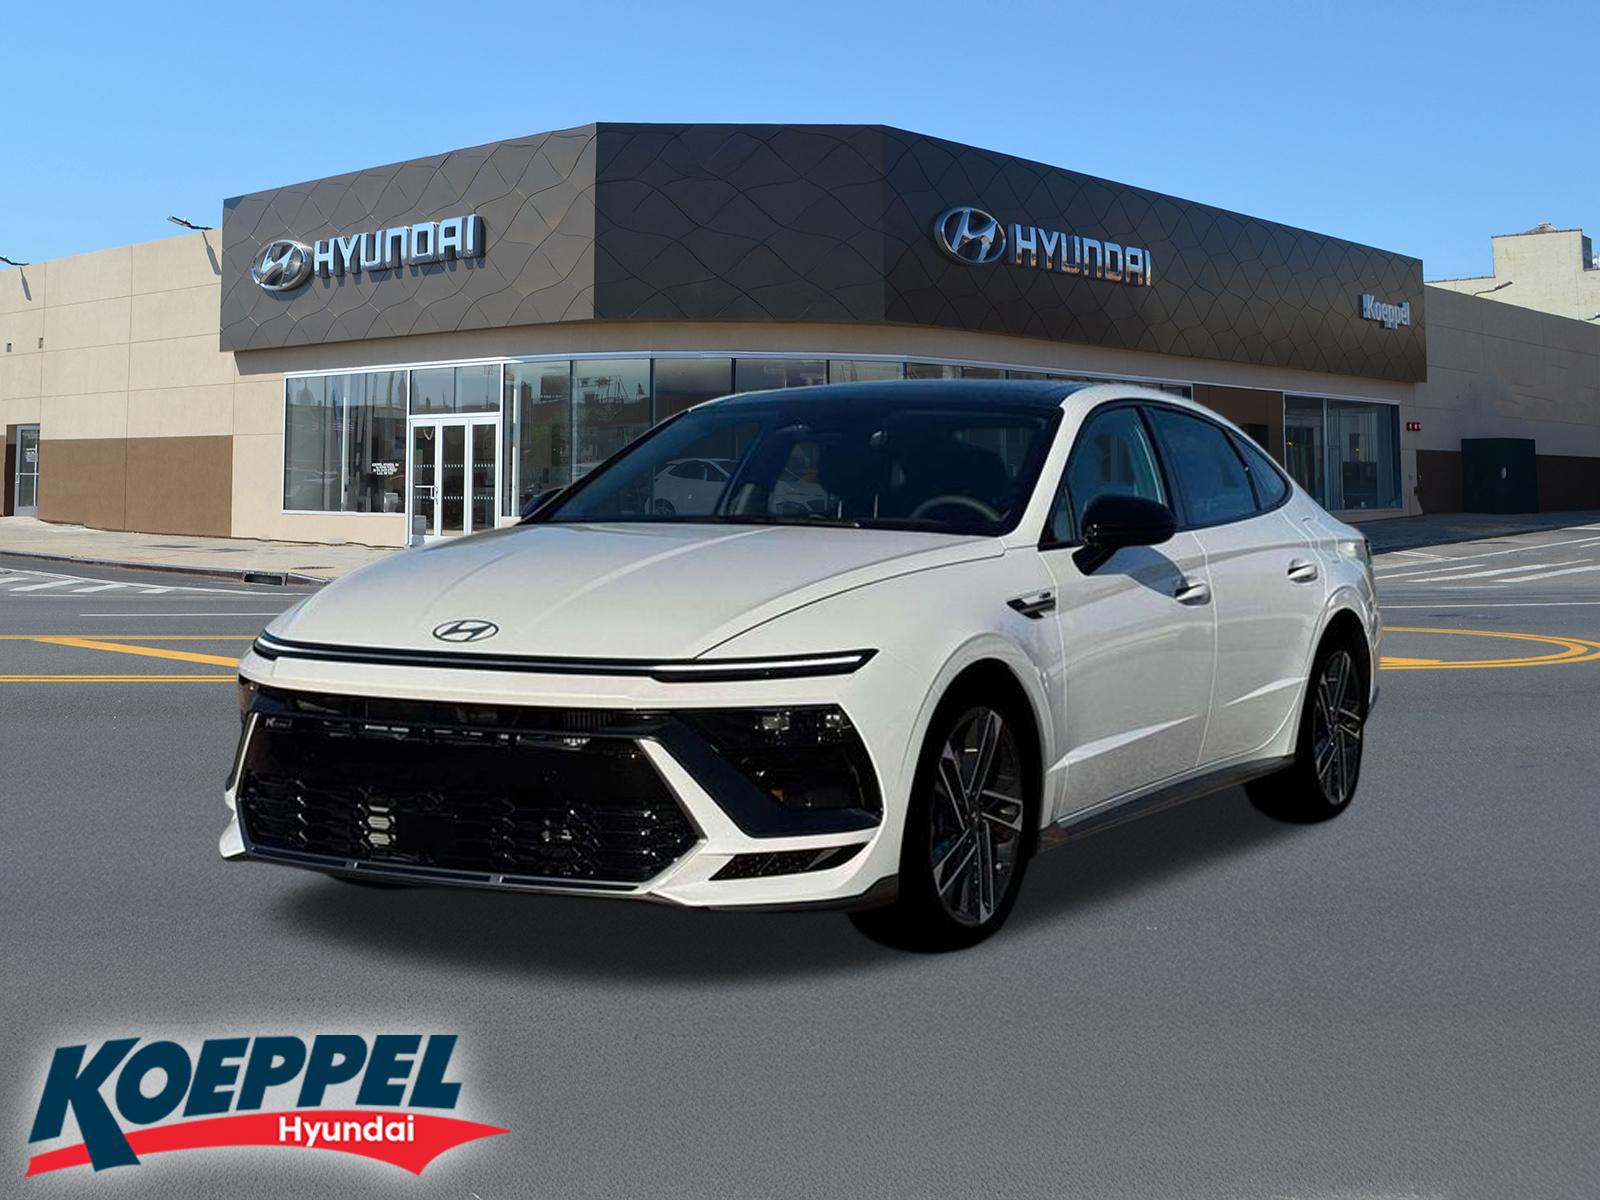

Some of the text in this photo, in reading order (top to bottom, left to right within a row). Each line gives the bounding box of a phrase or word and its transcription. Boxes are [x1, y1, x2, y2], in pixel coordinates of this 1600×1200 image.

[313, 214, 483, 278] HYUNDAI
[1014, 223, 1151, 286] HYUNDAI
[1361, 293, 1410, 329] Koeppel
